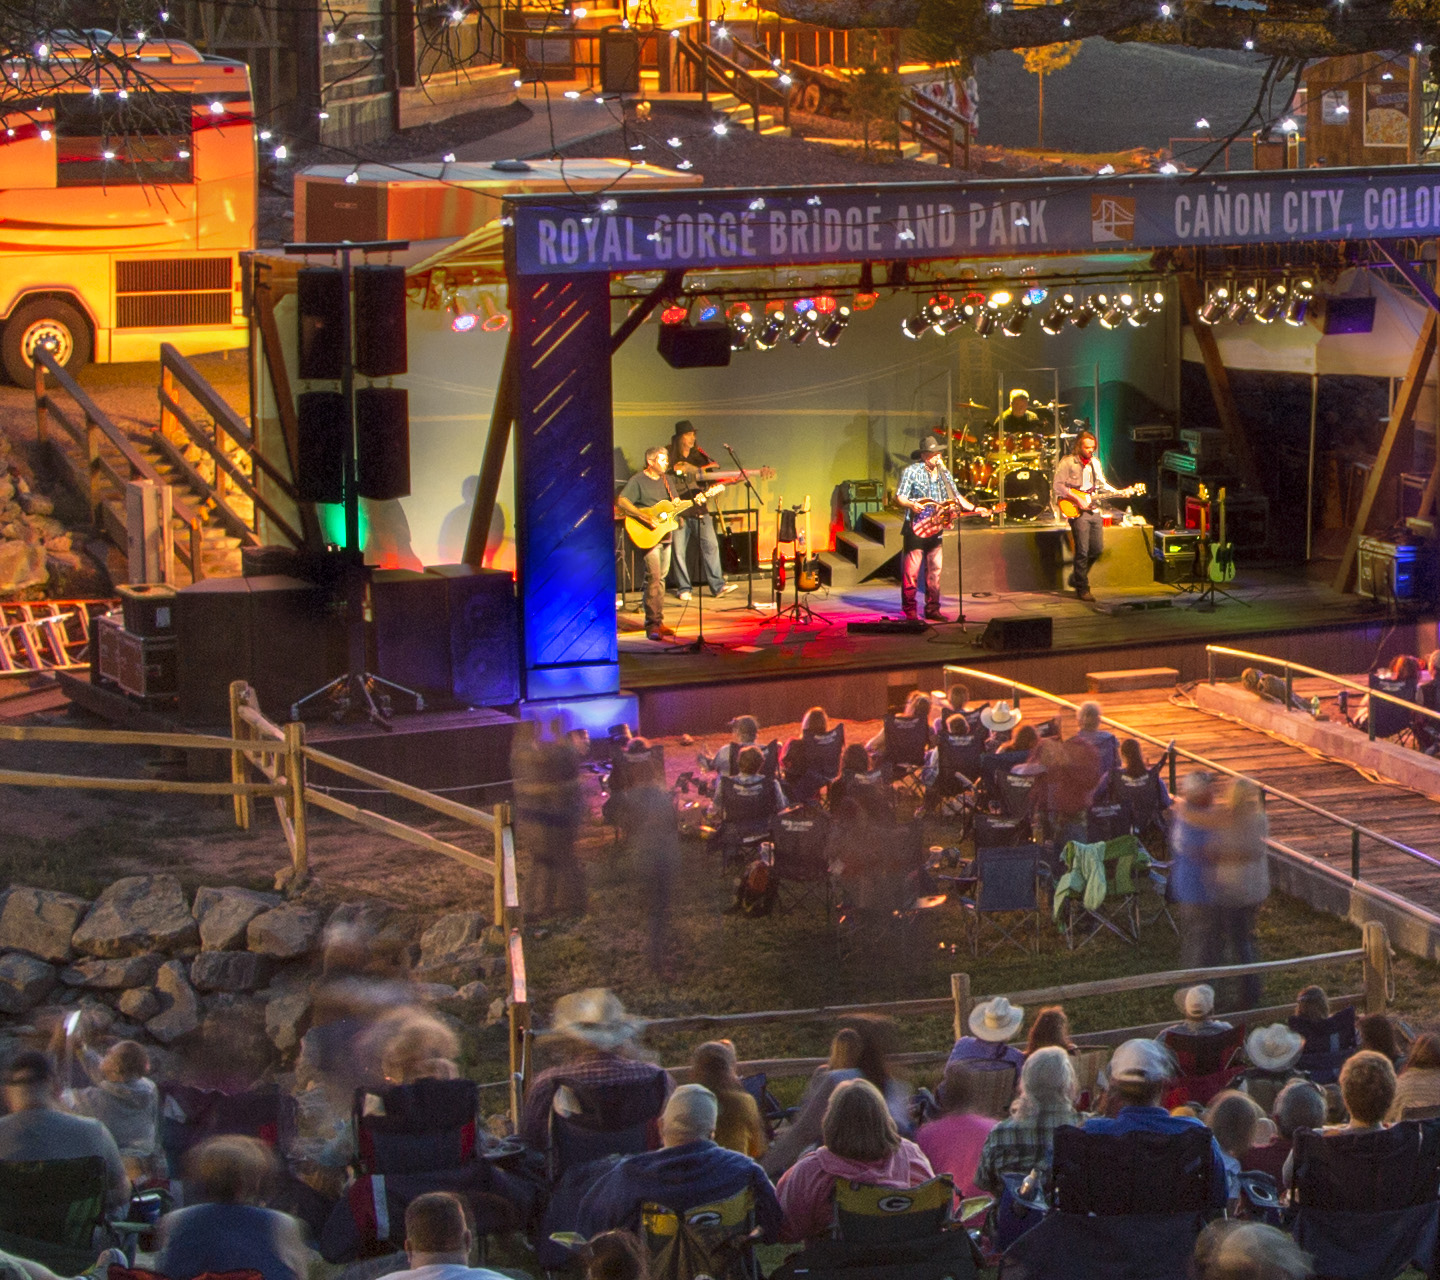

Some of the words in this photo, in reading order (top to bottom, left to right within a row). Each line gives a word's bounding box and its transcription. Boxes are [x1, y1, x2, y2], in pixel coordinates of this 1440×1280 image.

[538, 215, 641, 265] ROYAL
[654, 211, 757, 260] GORGE
[769, 206, 882, 255] BRIDGE
[894, 204, 956, 250] AND
[969, 199, 1048, 247] PARK
[1174, 185, 1271, 239] CAÑON
[1282, 189, 1353, 238] CITY,
